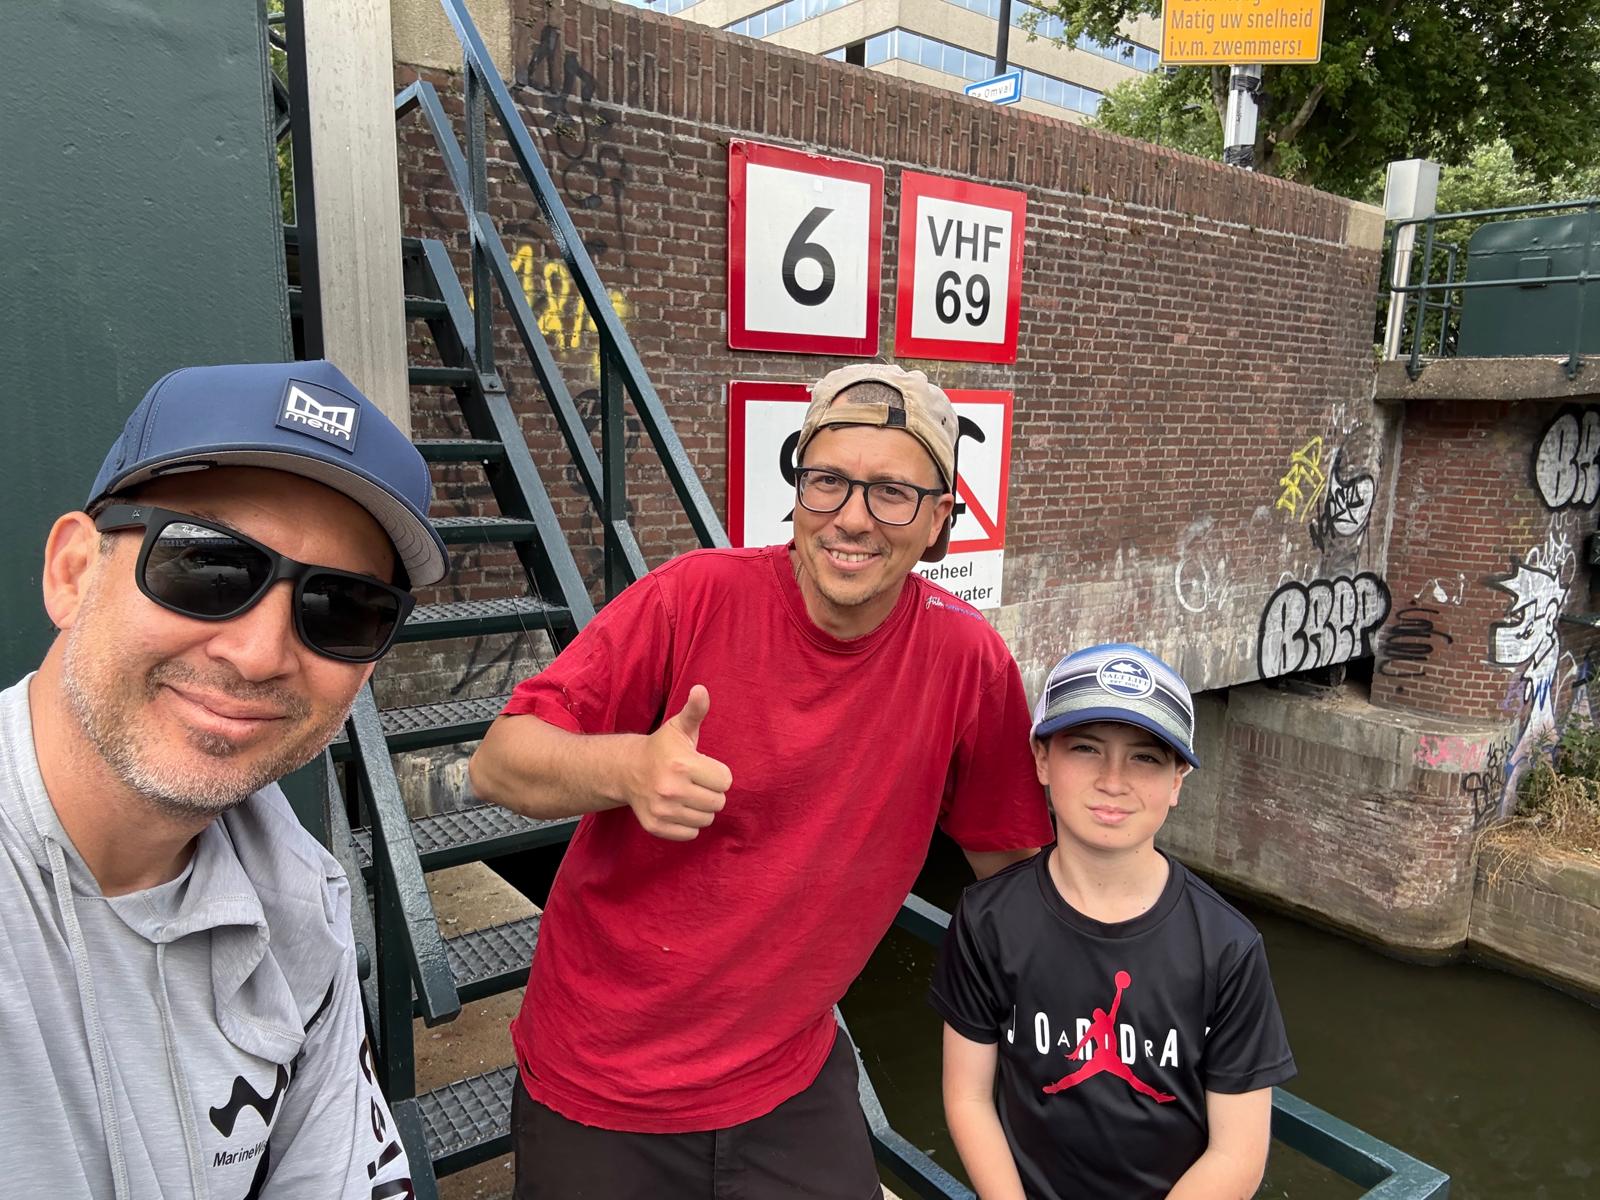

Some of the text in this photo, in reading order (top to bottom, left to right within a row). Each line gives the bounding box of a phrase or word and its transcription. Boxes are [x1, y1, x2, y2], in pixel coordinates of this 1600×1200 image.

[1170, 8, 1313, 34] Matig uw snelheid
[1169, 36, 1302, 57] i.v.m. zwemmers!
[927, 215, 1004, 263] VHF
[781, 206, 836, 307] 6
[935, 270, 991, 327] 69
[284, 411, 350, 441] melin
[919, 561, 973, 581] geheel
